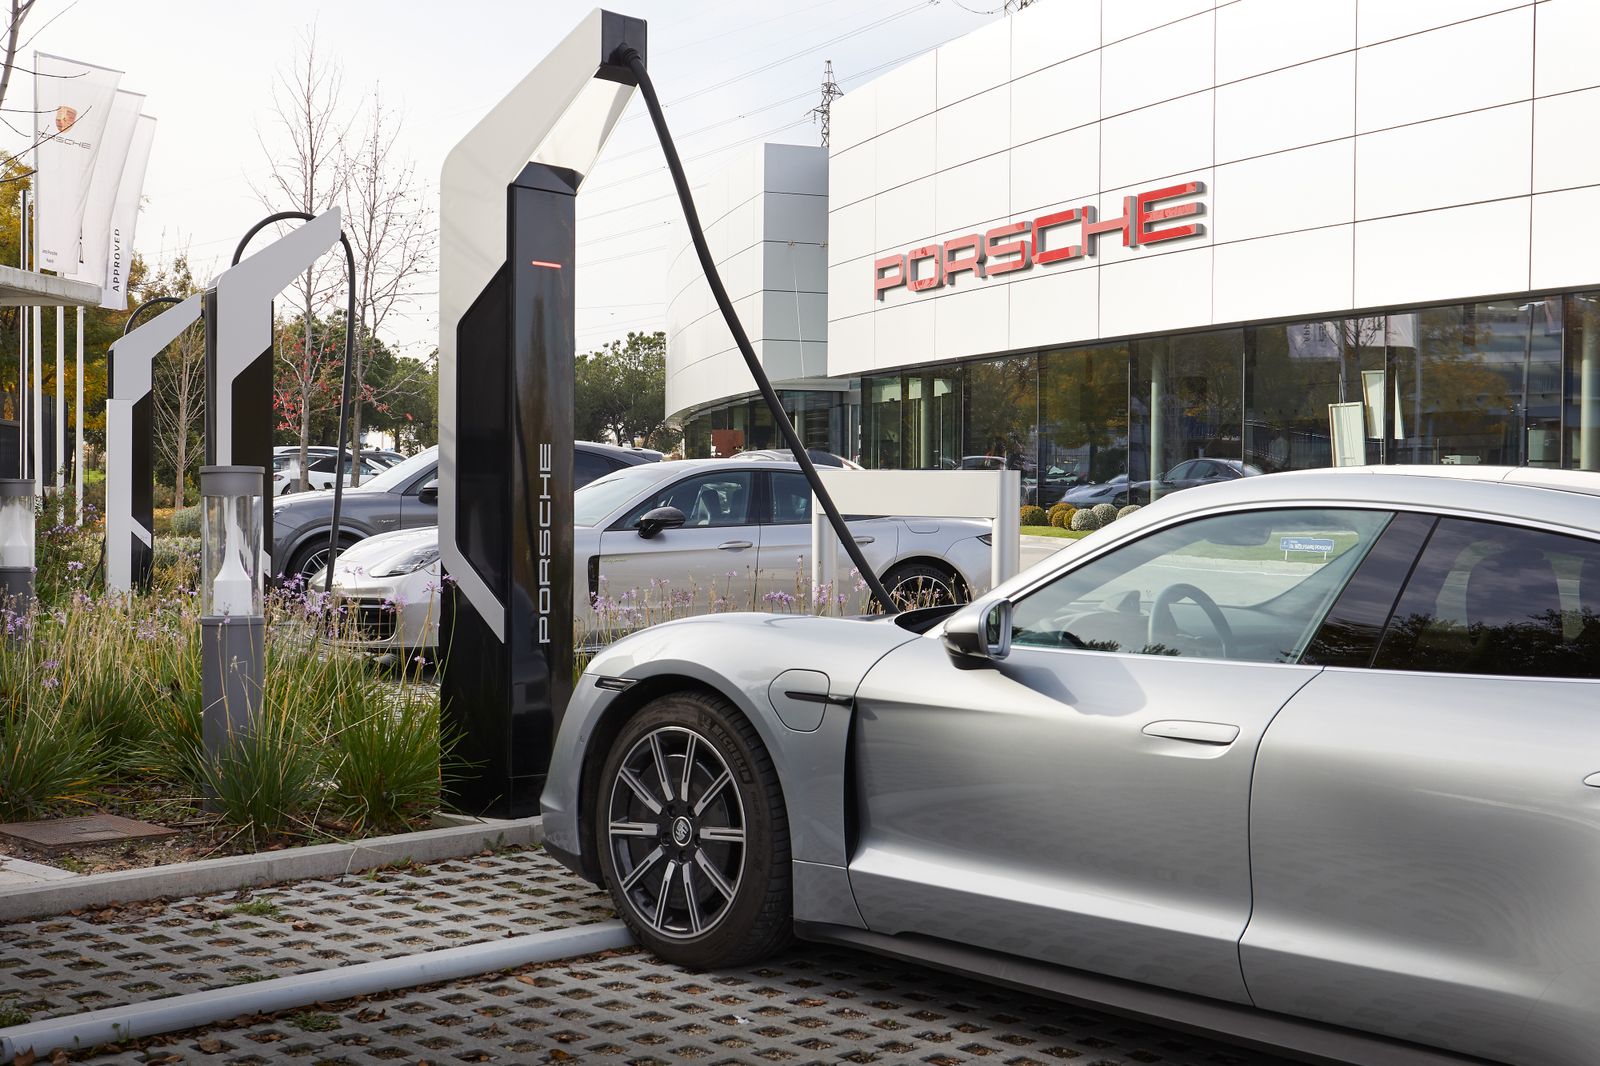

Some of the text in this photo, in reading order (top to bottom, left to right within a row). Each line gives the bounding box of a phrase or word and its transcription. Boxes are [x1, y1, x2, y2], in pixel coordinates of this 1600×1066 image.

[112, 228, 121, 292] APPROVED
[874, 181, 1207, 302] PORSCHE
[538, 443, 551, 644] PORSCHE
[712, 721, 753, 784] MICHELIN
